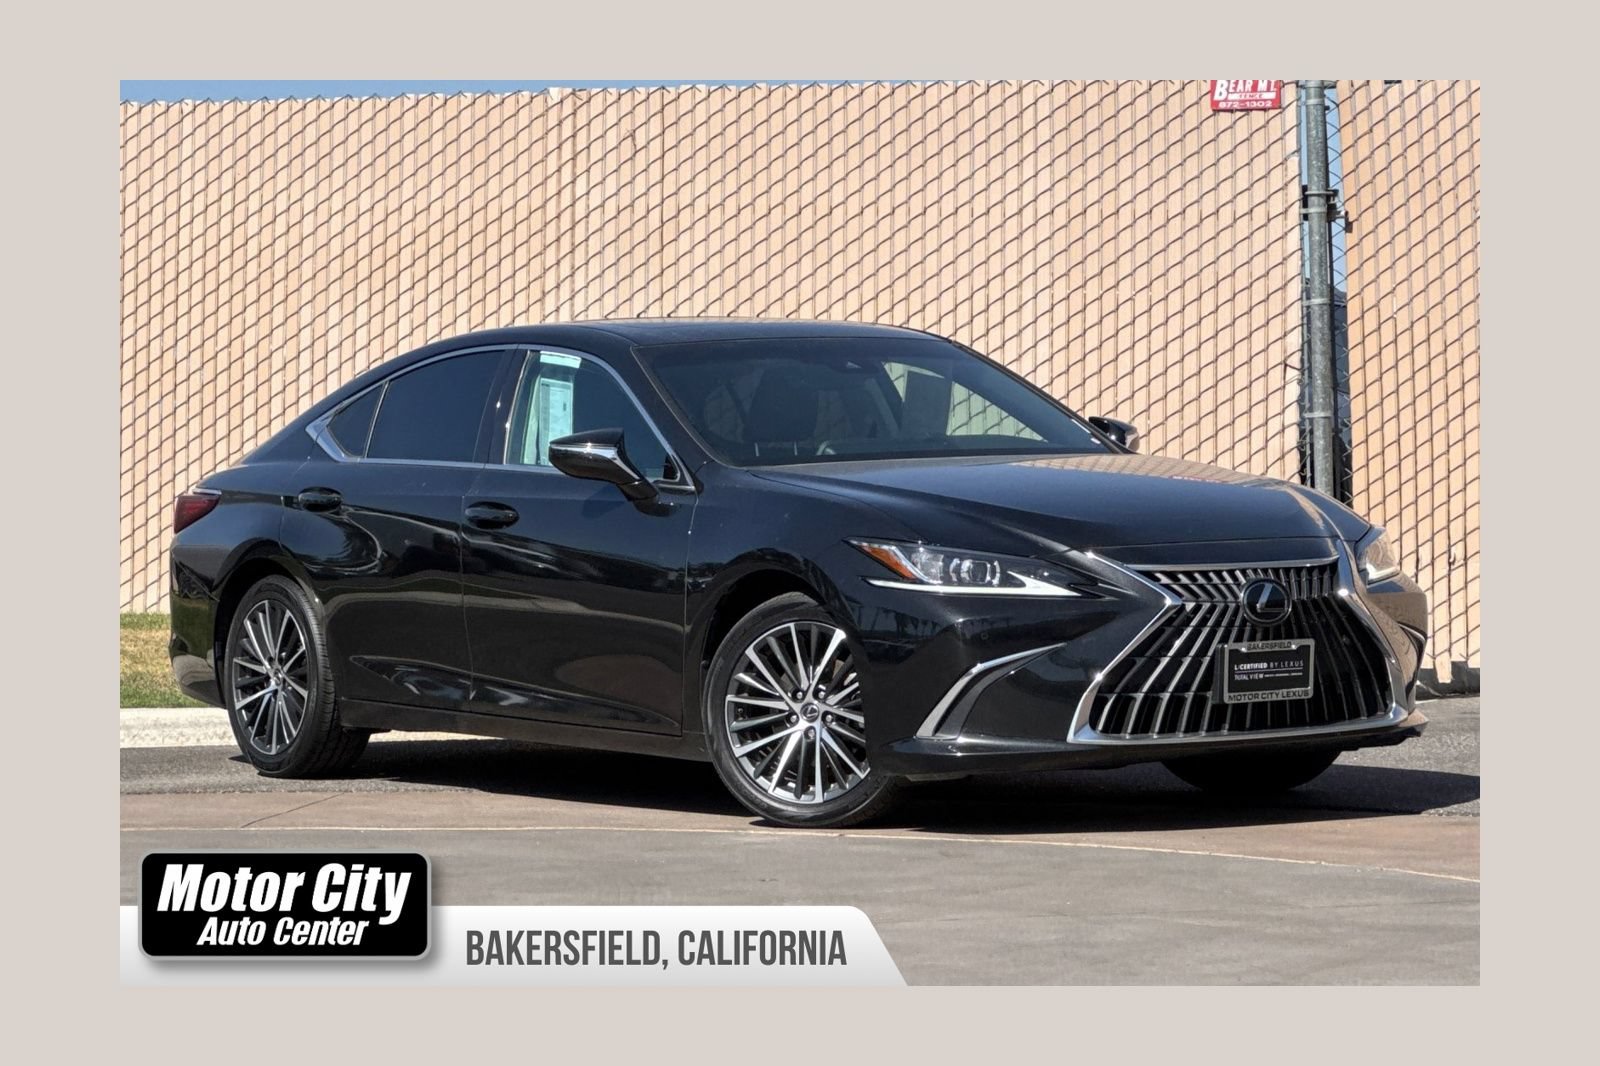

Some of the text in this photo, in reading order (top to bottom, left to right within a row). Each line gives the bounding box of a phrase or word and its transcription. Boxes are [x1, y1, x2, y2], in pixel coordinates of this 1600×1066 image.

[1214, 80, 1253, 100] BEAR
[1247, 641, 1292, 650] BAKERSFIELD
[1228, 689, 1309, 701] MOTOR CITY LEXUS
